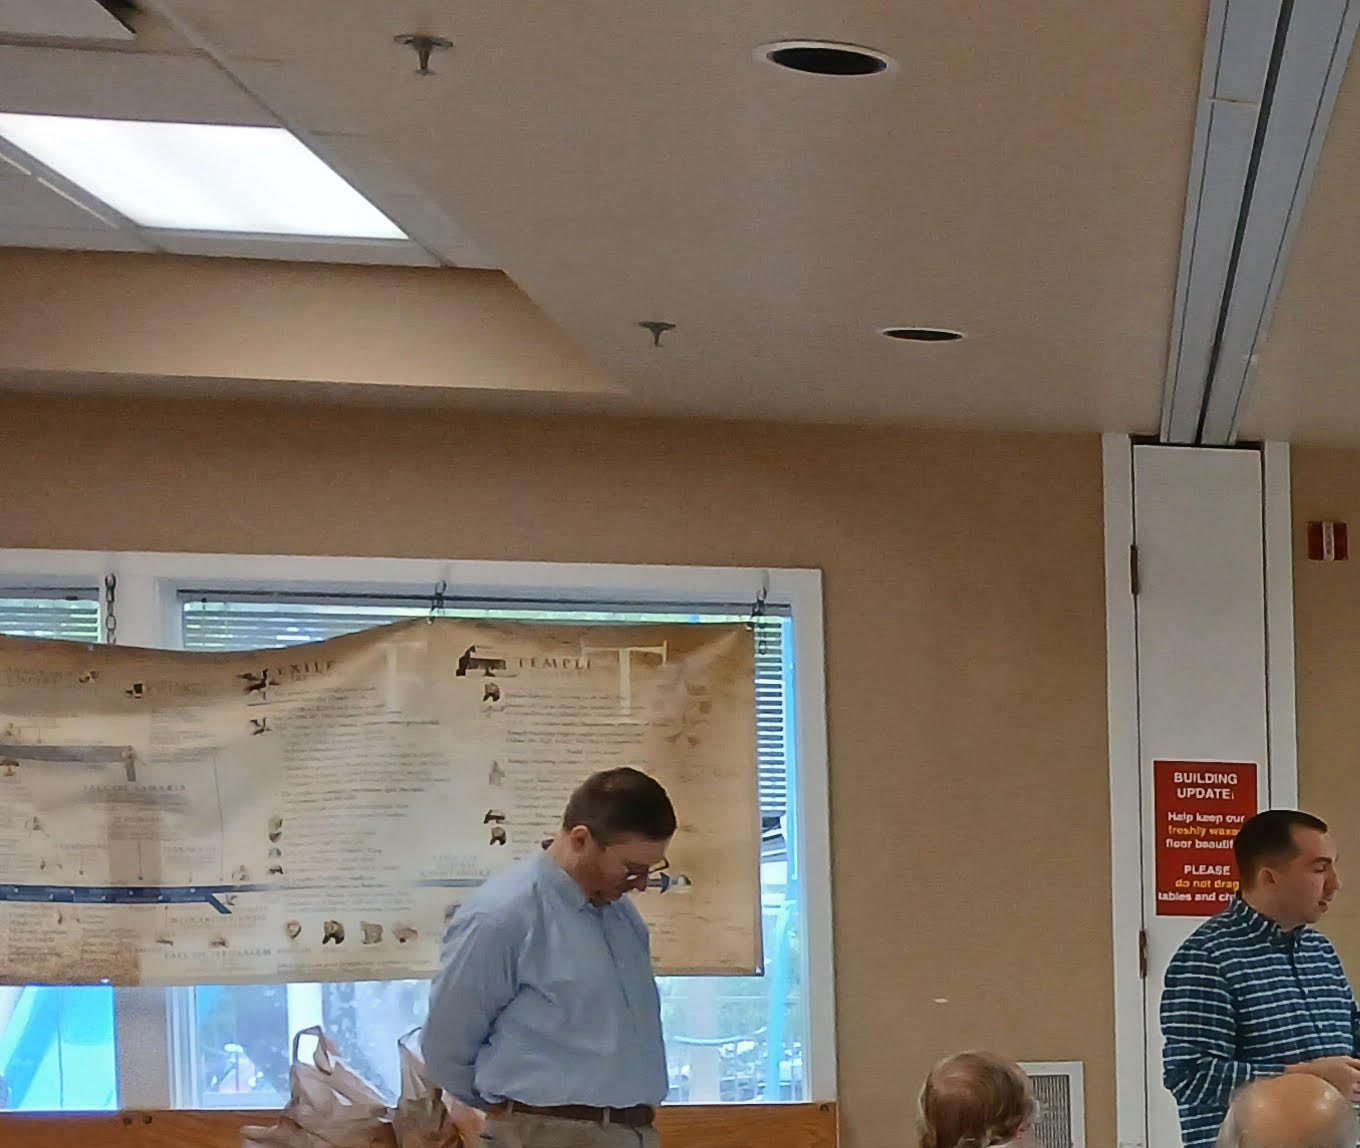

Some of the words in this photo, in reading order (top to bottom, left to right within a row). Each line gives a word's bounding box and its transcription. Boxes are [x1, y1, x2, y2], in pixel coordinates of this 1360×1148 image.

[519, 657, 592, 670] TEMPLE
[1174, 772, 1238, 785] BUILDING
[1168, 812, 1193, 824] Help
[1196, 813, 1223, 824] keep
[1226, 815, 1245, 824] our
[1168, 825, 1206, 837] freshly
[1166, 838, 1193, 849] floor
[1195, 839, 1234, 849] beautif
[1184, 865, 1231, 876] PLEASE
[1175, 879, 1190, 888] do
[1193, 880, 1211, 888] not
[1214, 879, 1240, 890] drag
[1158, 892, 1192, 901] tables
[1195, 892, 1216, 901] and
